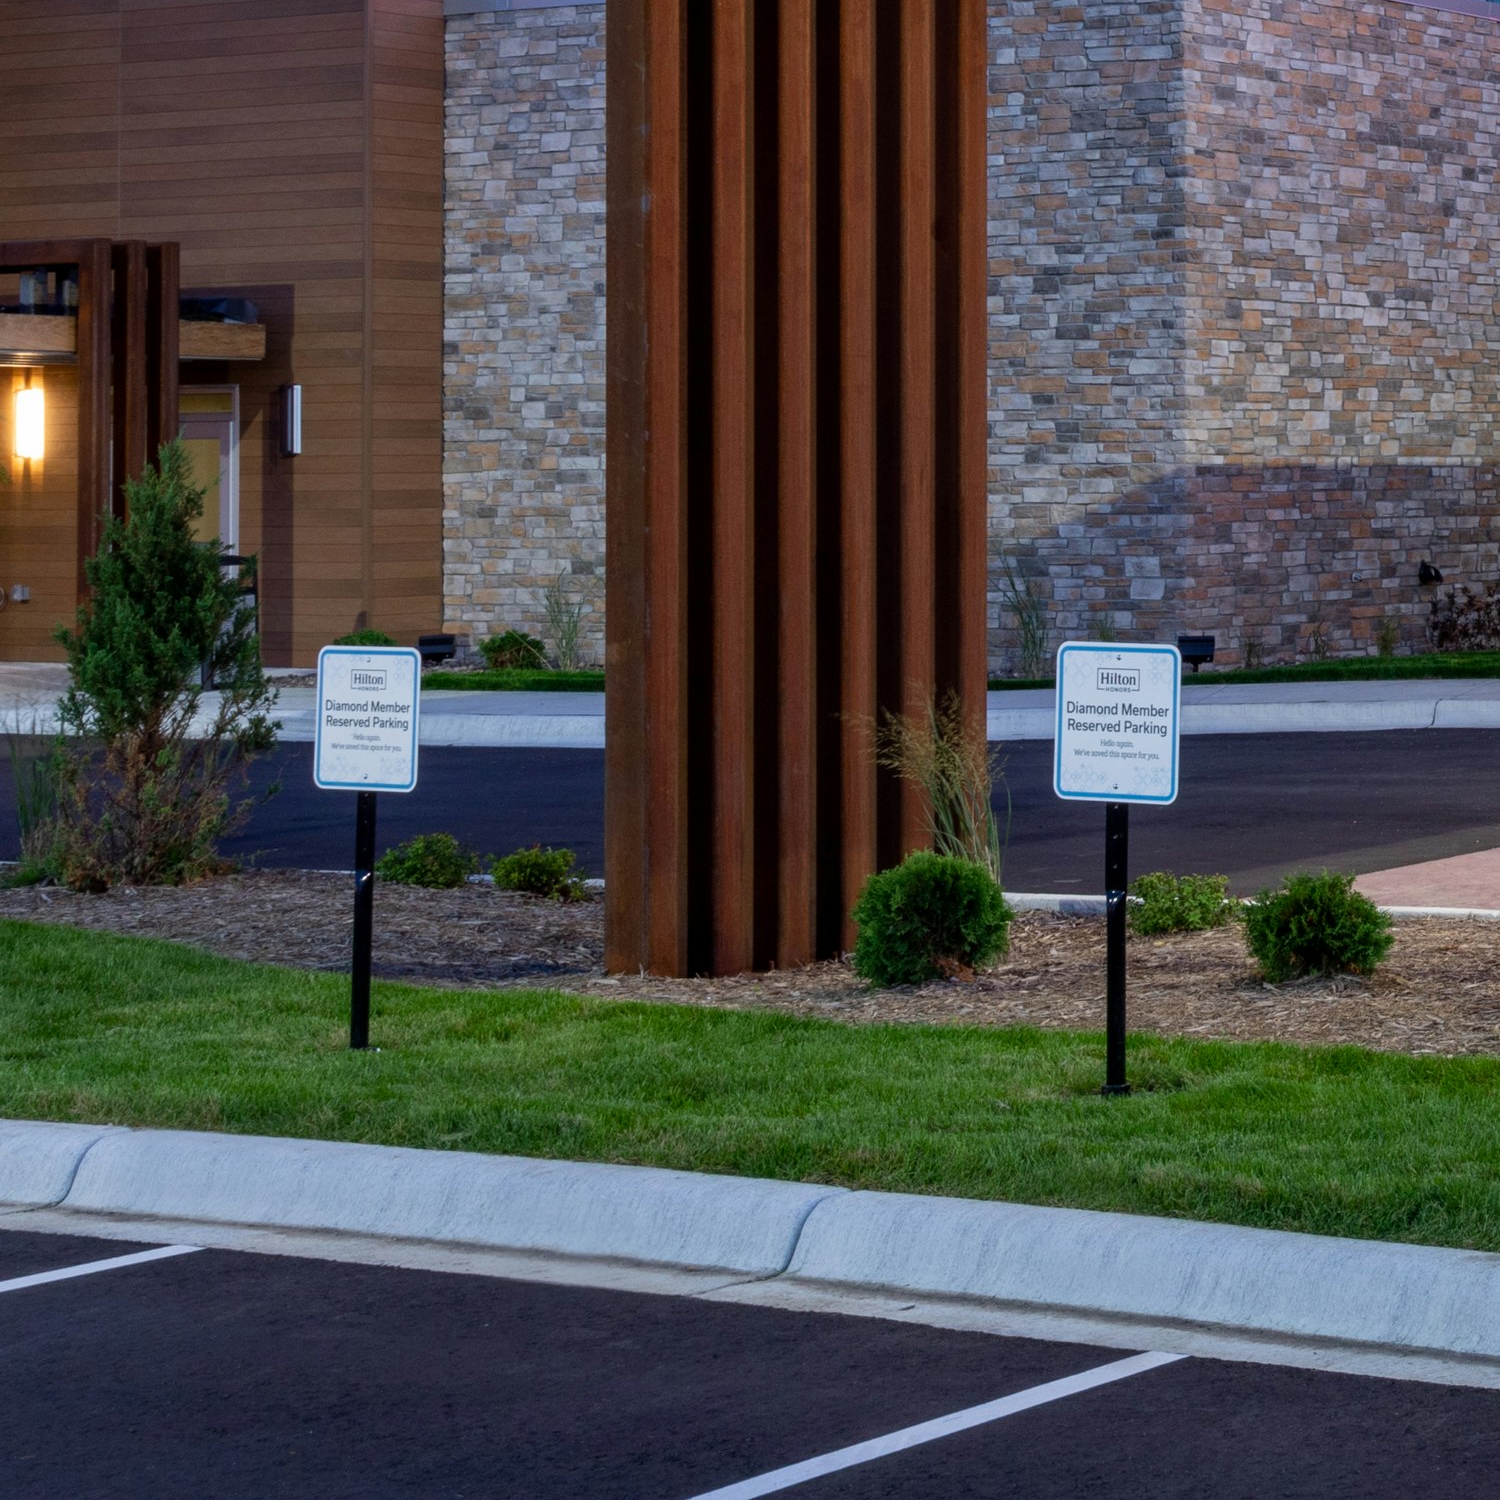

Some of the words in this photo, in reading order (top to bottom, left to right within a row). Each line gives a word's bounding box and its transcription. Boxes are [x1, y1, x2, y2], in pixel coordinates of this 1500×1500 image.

[354, 673, 383, 684] Hilton
[1101, 672, 1136, 686] Hilton
[325, 700, 368, 712] Diamond
[371, 701, 411, 713] Member
[1066, 701, 1118, 715] Diamond
[1121, 703, 1169, 717] Member
[326, 715, 370, 728] Reserved
[373, 717, 409, 731] Parking
[1068, 718, 1120, 732] Reserved
[1124, 721, 1168, 737] Parking
